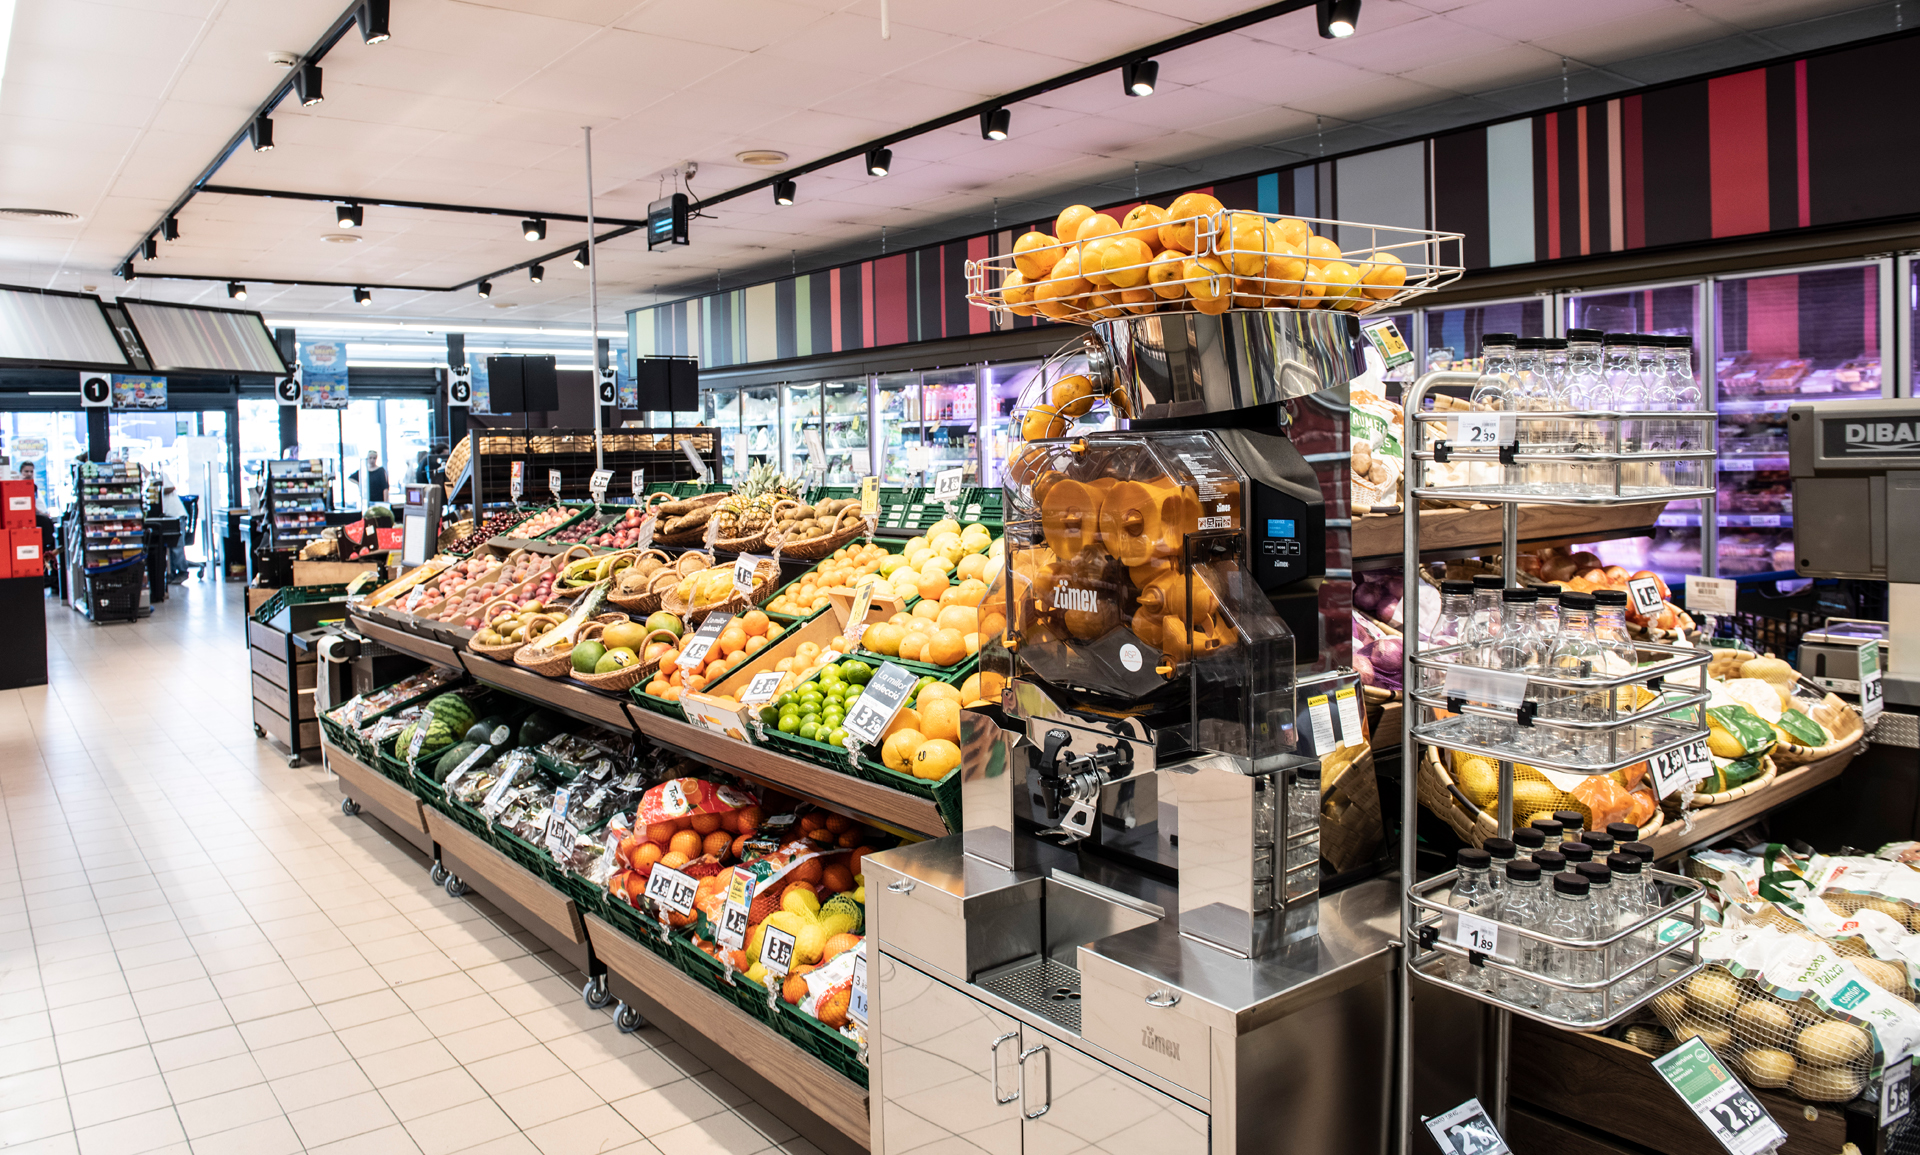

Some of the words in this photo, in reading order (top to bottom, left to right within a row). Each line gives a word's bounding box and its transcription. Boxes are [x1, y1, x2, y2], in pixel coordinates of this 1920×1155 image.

[91, 383, 99, 397] 1
[286, 383, 296, 396] 2
[457, 384, 468, 398] 3
[603, 386, 611, 398] 4
[1470, 426, 1496, 443] 2,39
[878, 670, 888, 679] La
[886, 676, 908, 691] millor
[871, 681, 901, 701] selecció
[856, 707, 881, 734] 3,29
[1659, 753, 1683, 778] 2,99
[1470, 929, 1494, 951] 1,89
[769, 938, 790, 964] 3,57
[1715, 1101, 1761, 1131] 2,99
